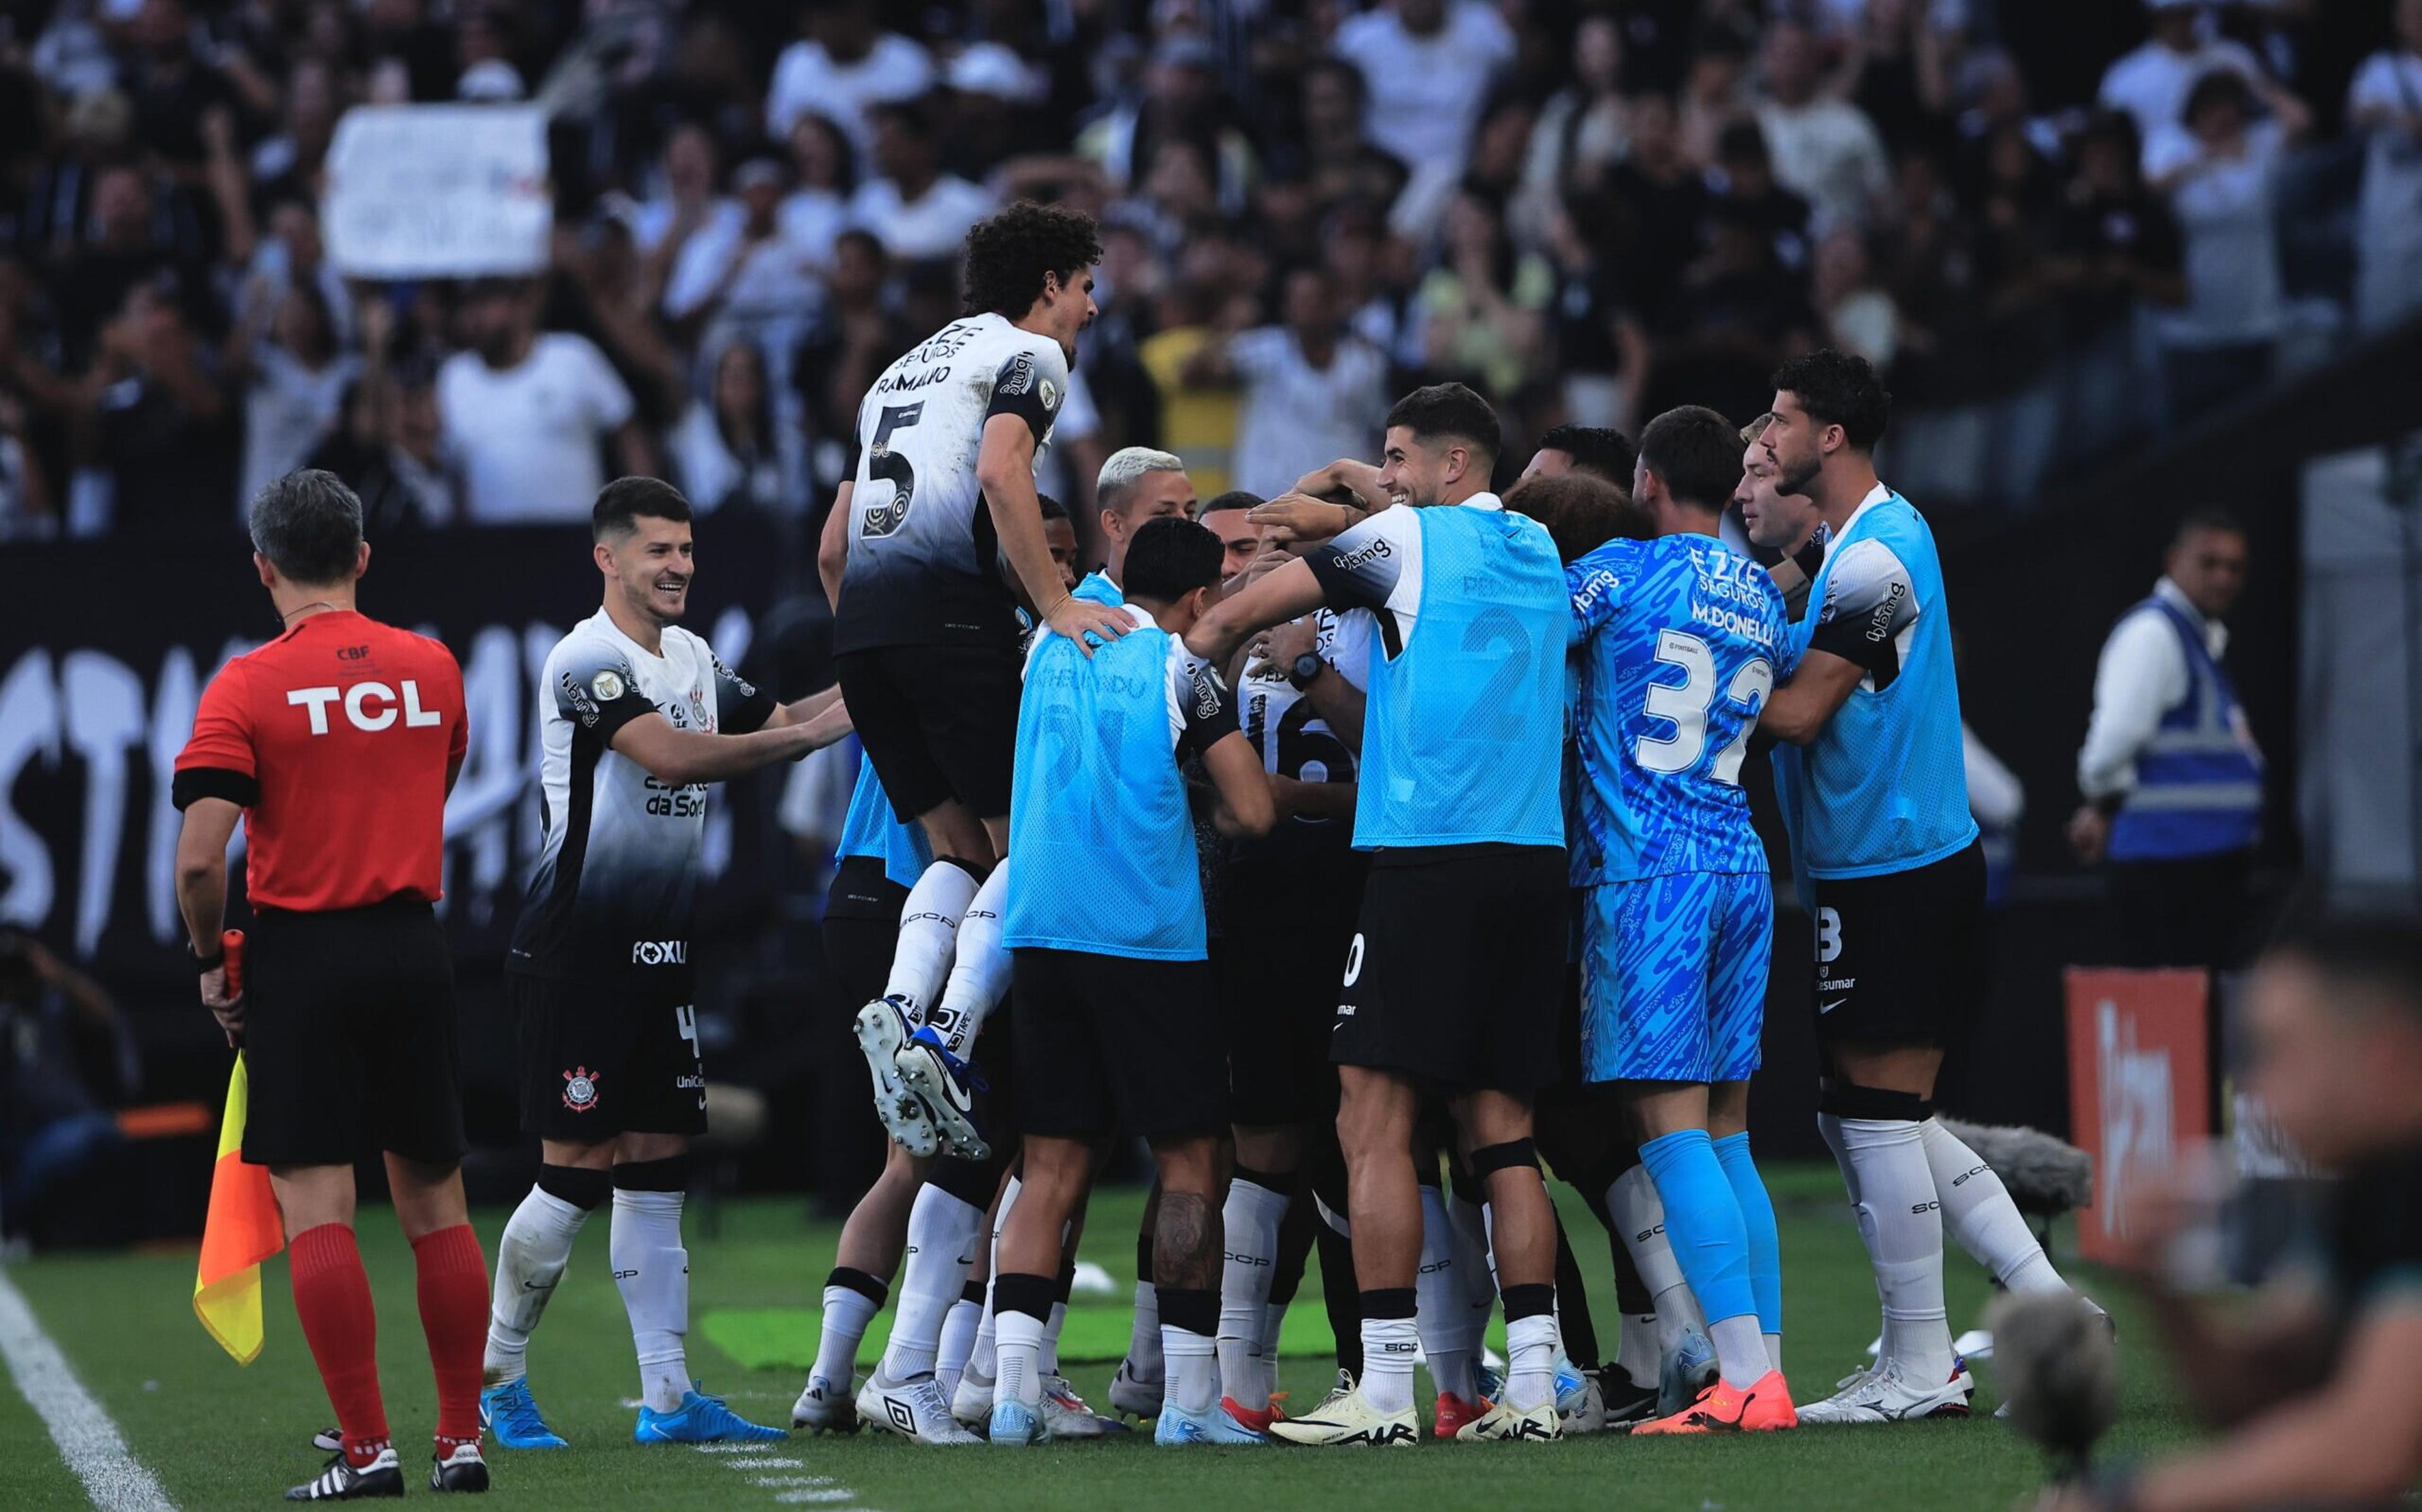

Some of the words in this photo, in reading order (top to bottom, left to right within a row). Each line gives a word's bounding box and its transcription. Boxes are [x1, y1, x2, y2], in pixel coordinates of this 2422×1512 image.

[860, 399, 925, 540] 5
[1574, 569, 1620, 608] bmg
[1690, 547, 1767, 595] EZZE
[1699, 574, 1766, 613] SEGUROS
[336, 645, 377, 661] CBF
[287, 679, 442, 736] TCL
[1635, 628, 1774, 786] 32
[646, 794, 672, 816] da
[675, 1004, 701, 1059] 4
